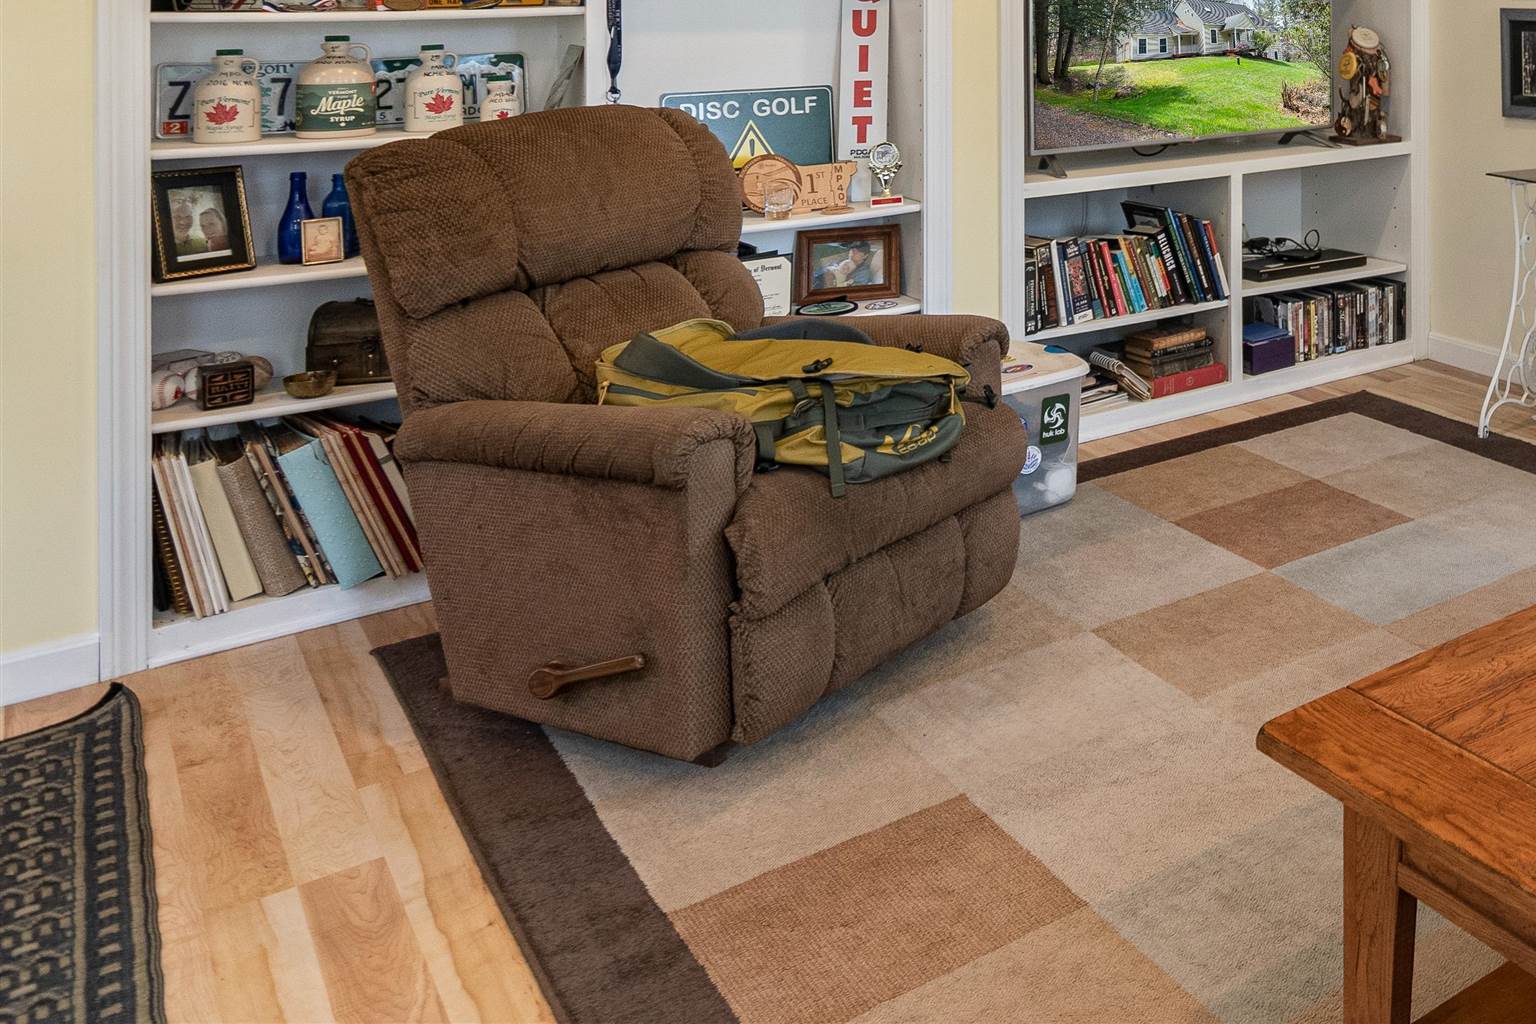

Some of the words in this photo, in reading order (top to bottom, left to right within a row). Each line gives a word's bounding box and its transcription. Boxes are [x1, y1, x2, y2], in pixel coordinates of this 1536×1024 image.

[310, 94, 365, 115] Maple
[679, 100, 741, 122] DISC
[752, 95, 818, 117] GOLF
[329, 115, 356, 123] SYRUP
[169, 123, 181, 133] 2
[801, 197, 829, 207] PLACE
[1157, 232, 1177, 272] BELICHICK
